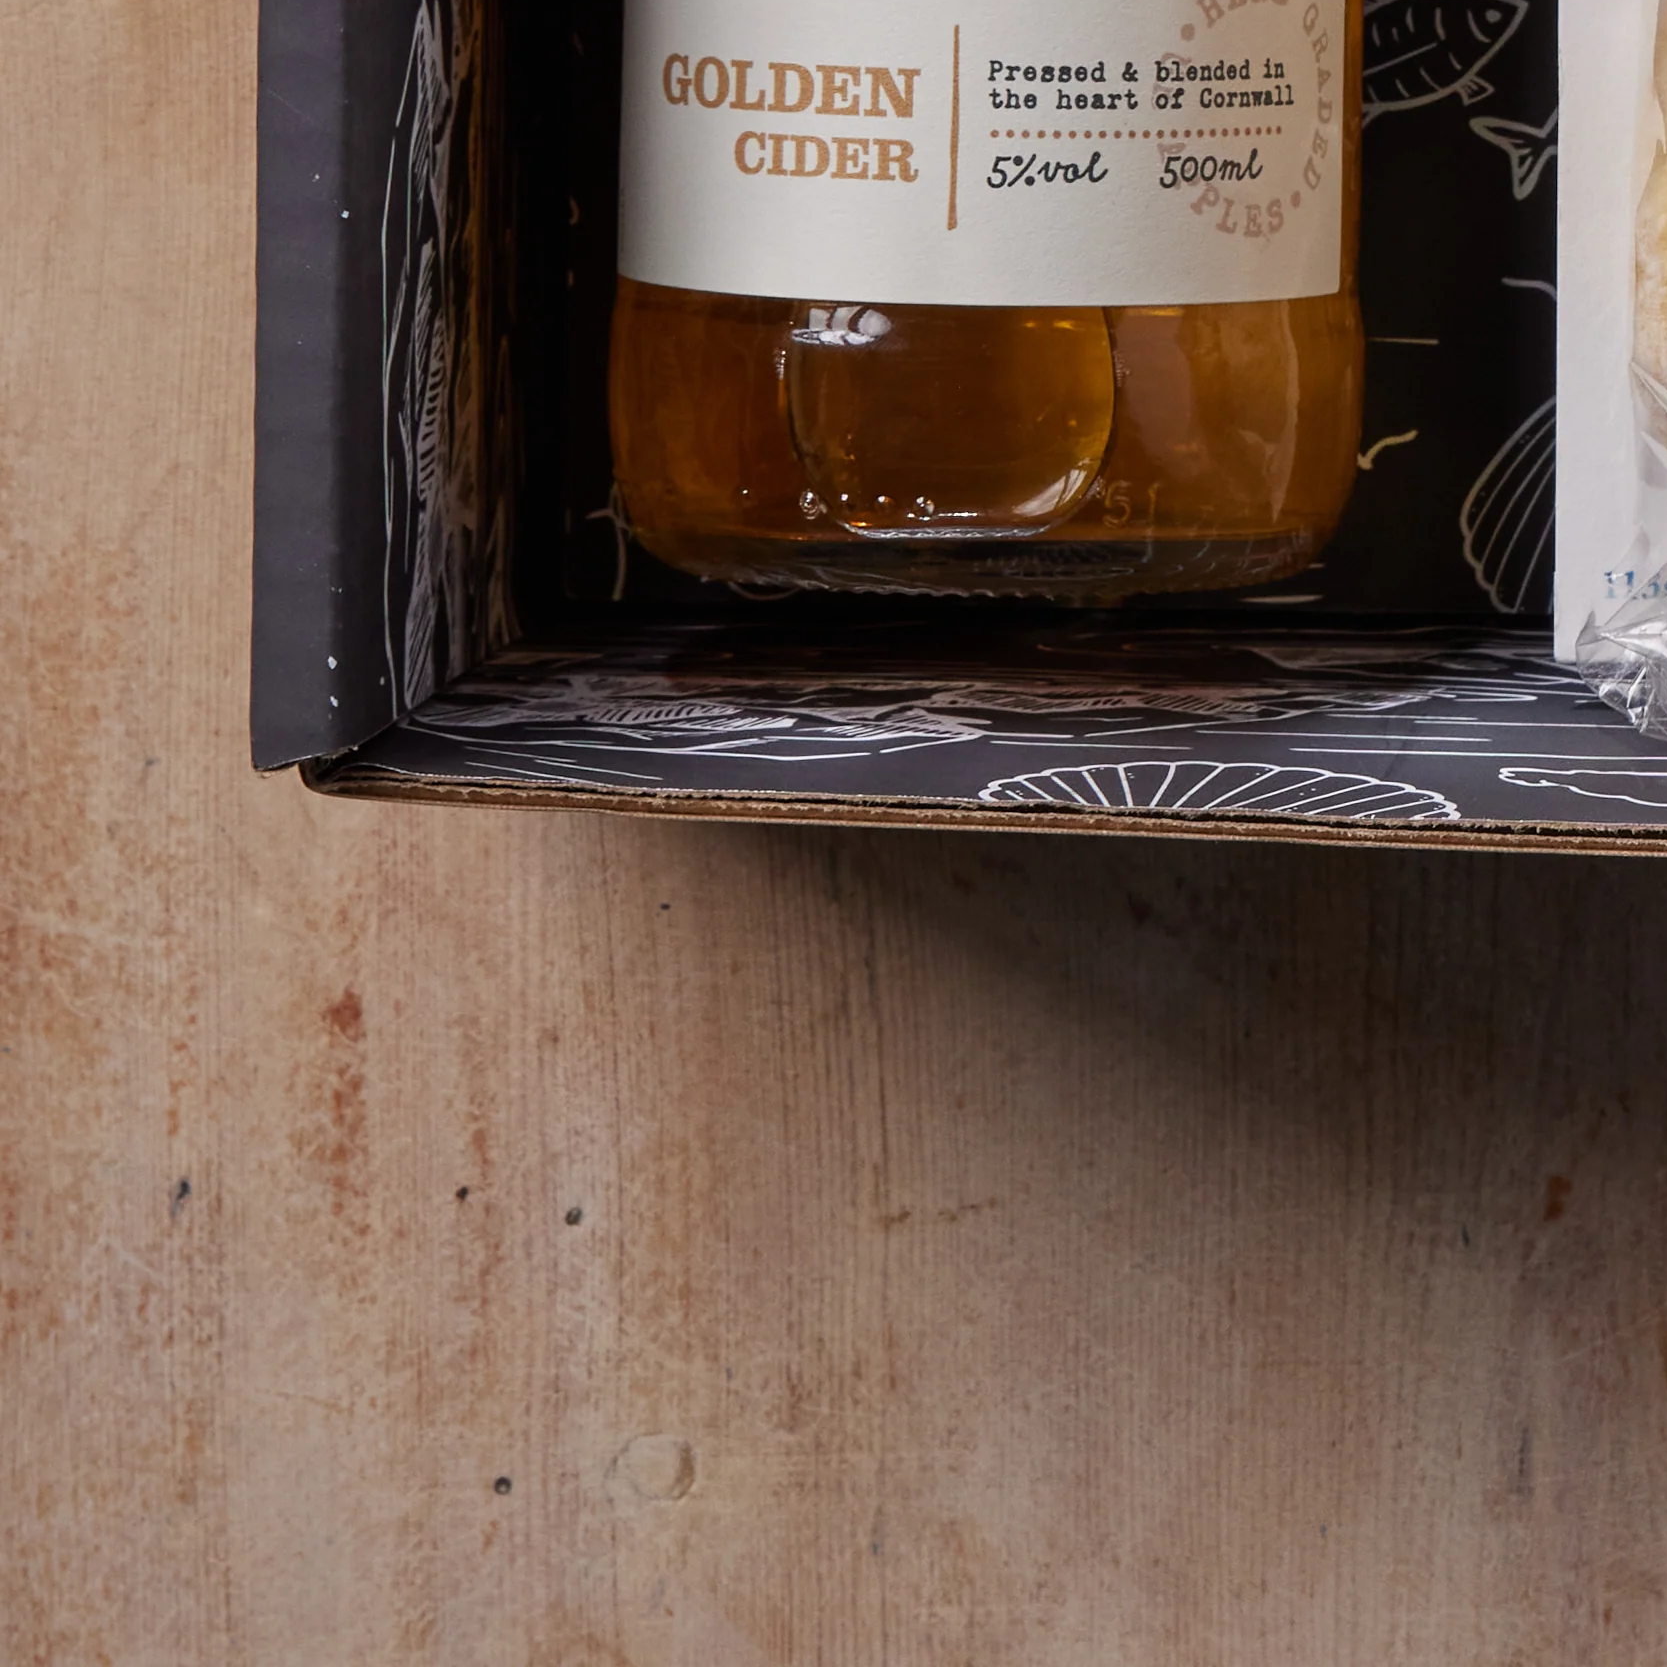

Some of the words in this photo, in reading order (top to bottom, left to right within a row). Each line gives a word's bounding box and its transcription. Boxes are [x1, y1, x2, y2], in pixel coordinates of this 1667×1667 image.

[661, 53, 921, 118] GOLDEN
[987, 60, 1107, 84] Pressed
[1121, 62, 1139, 83] &
[1155, 58, 1252, 82] blended
[1264, 58, 1285, 79] in
[989, 88, 1039, 110] the
[1056, 87, 1138, 110] heart
[1155, 87, 1185, 110] of
[1199, 84, 1295, 109] Cornwall
[733, 130, 919, 183] CIDER
[1159, 148, 1263, 189] 500ml
